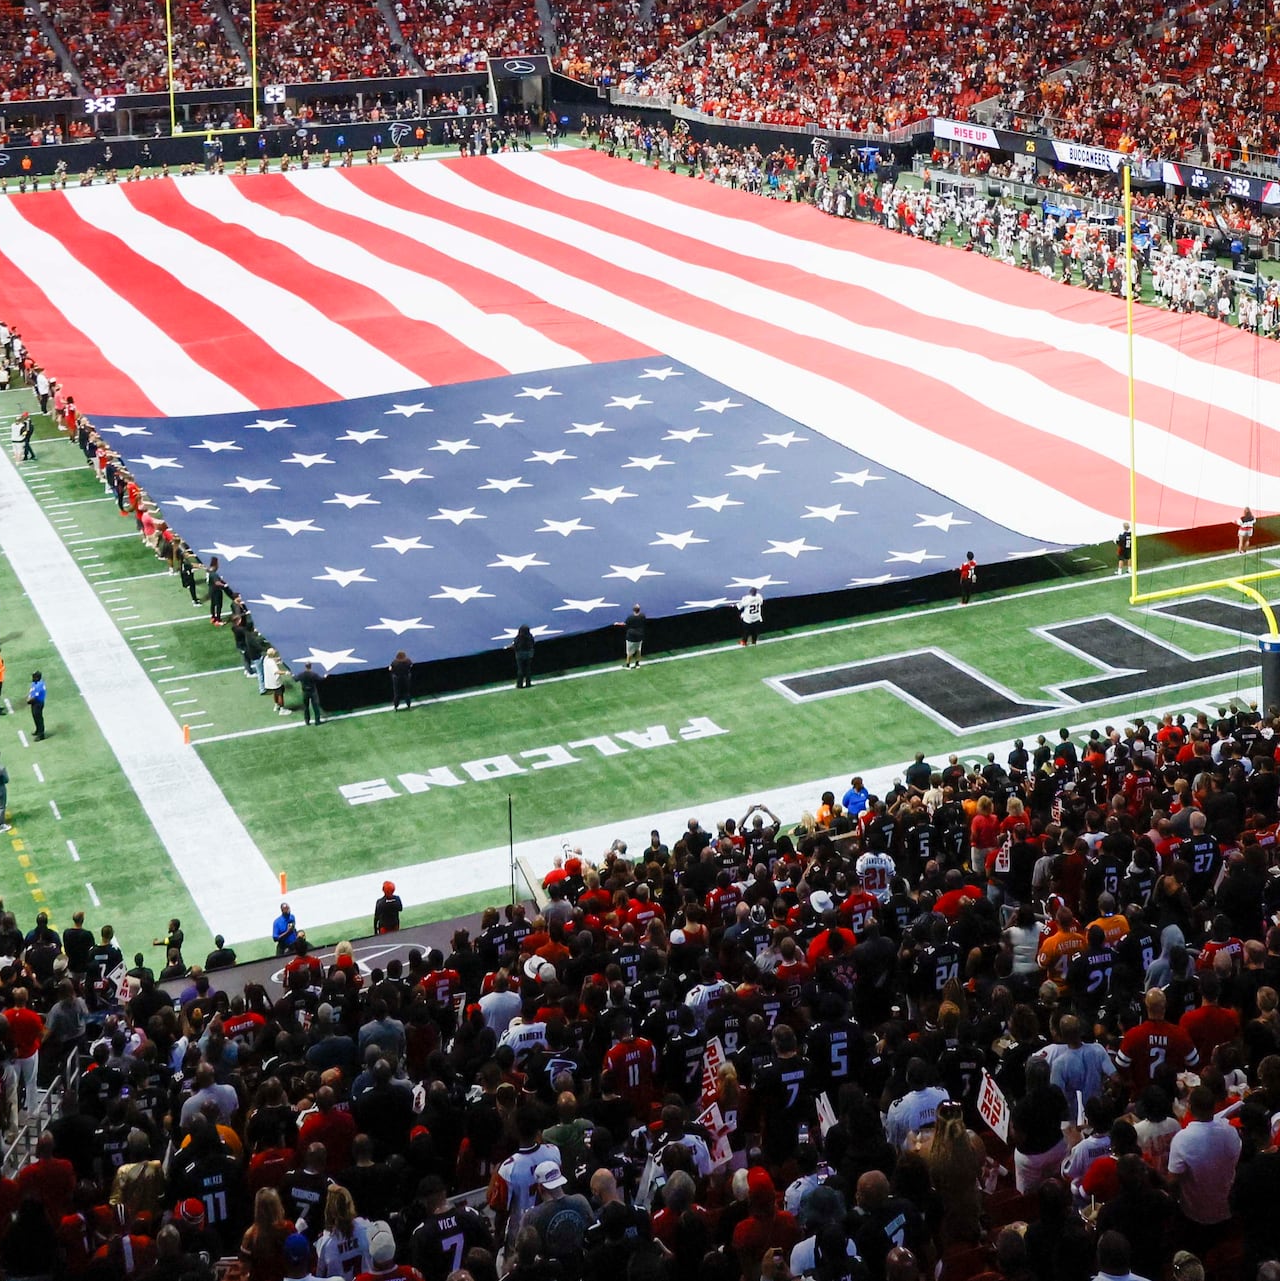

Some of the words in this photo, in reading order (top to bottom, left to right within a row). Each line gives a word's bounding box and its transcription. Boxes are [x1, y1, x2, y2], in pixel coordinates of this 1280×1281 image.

[265, 87, 285, 103] 25
[84, 98, 116, 114] 3:52
[953, 126, 973, 139] RISE
[975, 131, 988, 142] UP
[1025, 140, 1035, 153] 25
[1069, 147, 1111, 168] BUCCANEERS
[749, 603, 760, 615] 21
[337, 715, 732, 807] FALCONS
[884, 830, 895, 849] 7
[919, 839, 930, 858] 5
[1193, 852, 1215, 874] 27
[864, 868, 887, 890] 21
[1104, 875, 1118, 894] 13
[852, 910, 873, 934] 24
[1139, 936, 1153, 947] PITTS
[1087, 953, 1112, 967] SANDERS
[1142, 947, 1154, 971] 8
[1198, 950, 1209, 962] 21
[98, 963, 106, 980] 7
[627, 965, 638, 984] 9
[935, 962, 959, 990] 24
[1087, 967, 1113, 993] 21
[436, 986, 450, 1009] 5
[691, 987, 701, 997] 7
[229, 1019, 255, 1033] SANDERS
[725, 1017, 739, 1029] PITTS
[765, 1010, 778, 1031] 7
[519, 1031, 544, 1042] SANDERS
[723, 1031, 739, 1056] 8
[1149, 1034, 1168, 1046] RYAN
[625, 1050, 641, 1062] JONES
[831, 1042, 848, 1078] 5
[628, 1064, 640, 1087] 11
[686, 1060, 700, 1084] 7
[786, 1082, 800, 1109] 7
[202, 1190, 227, 1224] 11
[296, 1201, 311, 1219] 7
[437, 1215, 457, 1231] VICK
[337, 1237, 360, 1254] VICK
[441, 1232, 465, 1272] 7
